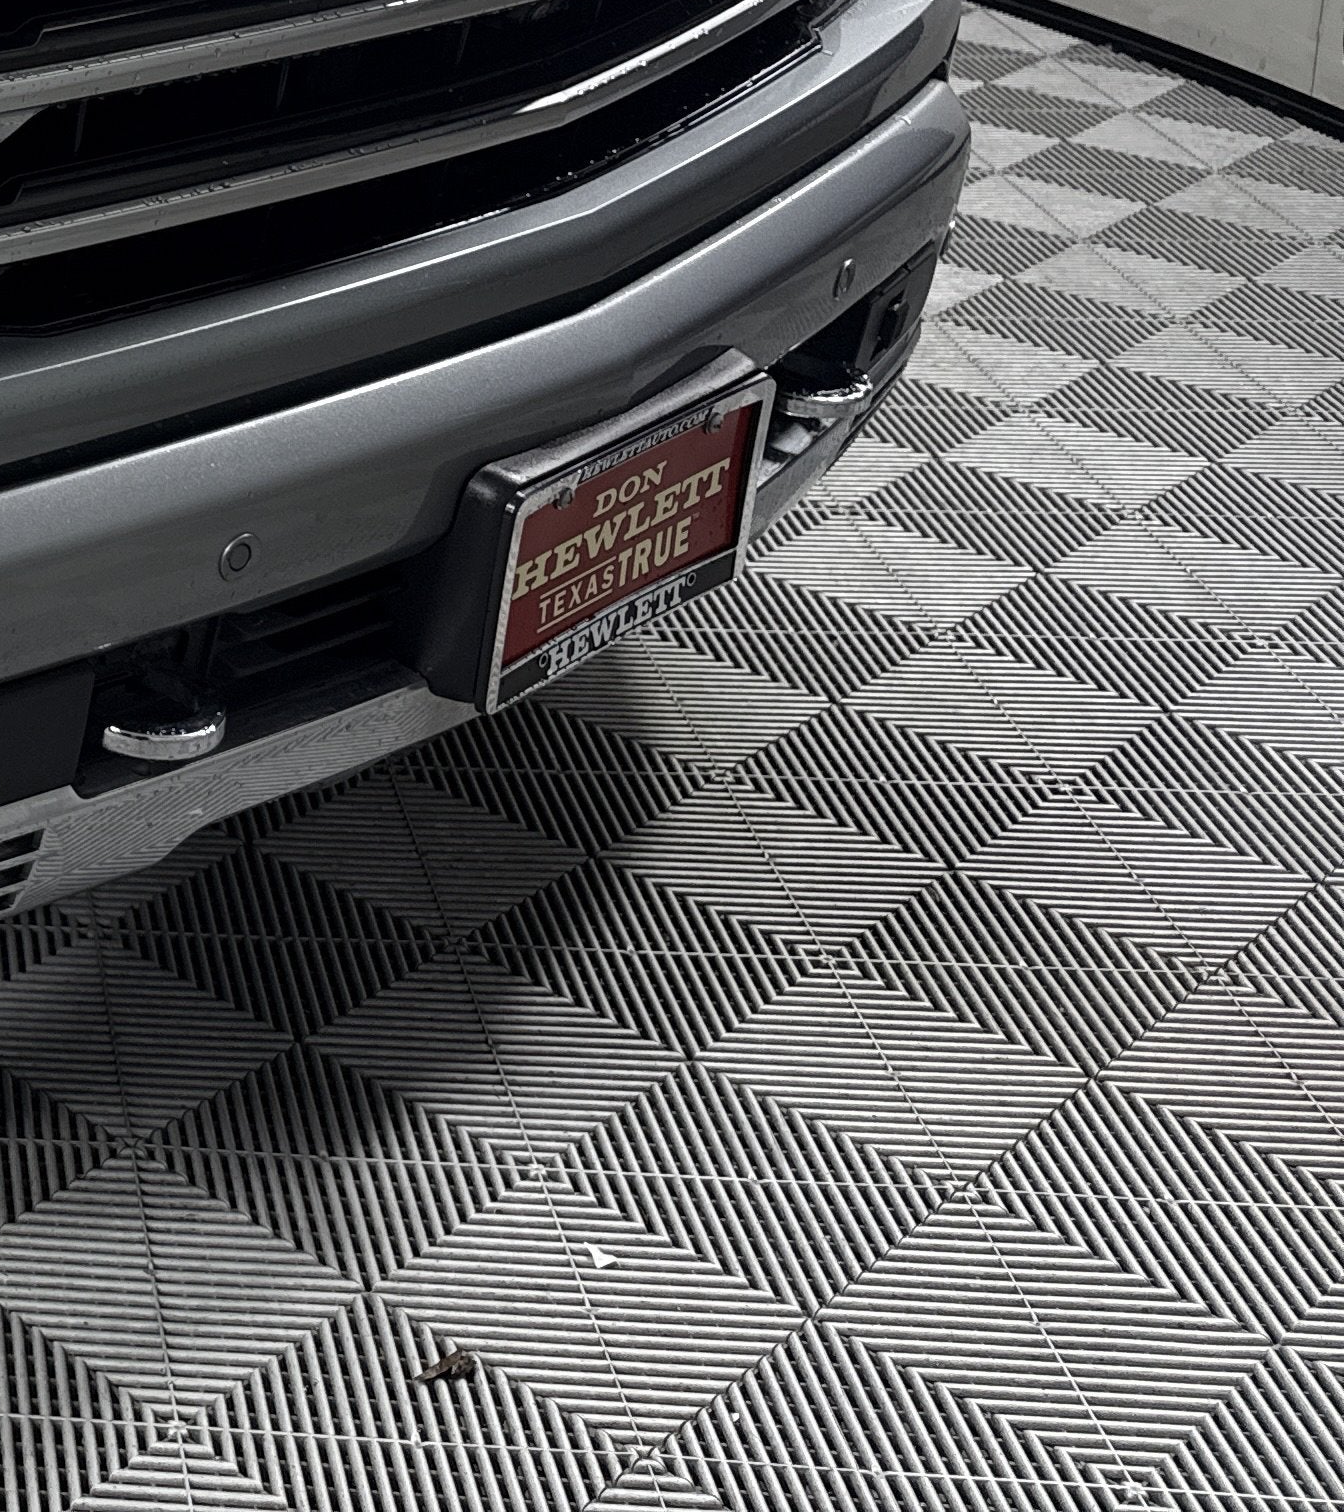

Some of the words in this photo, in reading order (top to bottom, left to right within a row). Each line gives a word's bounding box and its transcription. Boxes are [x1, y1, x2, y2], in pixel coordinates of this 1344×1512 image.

[512, 457, 730, 600] HEWLETT
[593, 460, 668, 519] DON
[546, 574, 686, 676] HEWLETT
